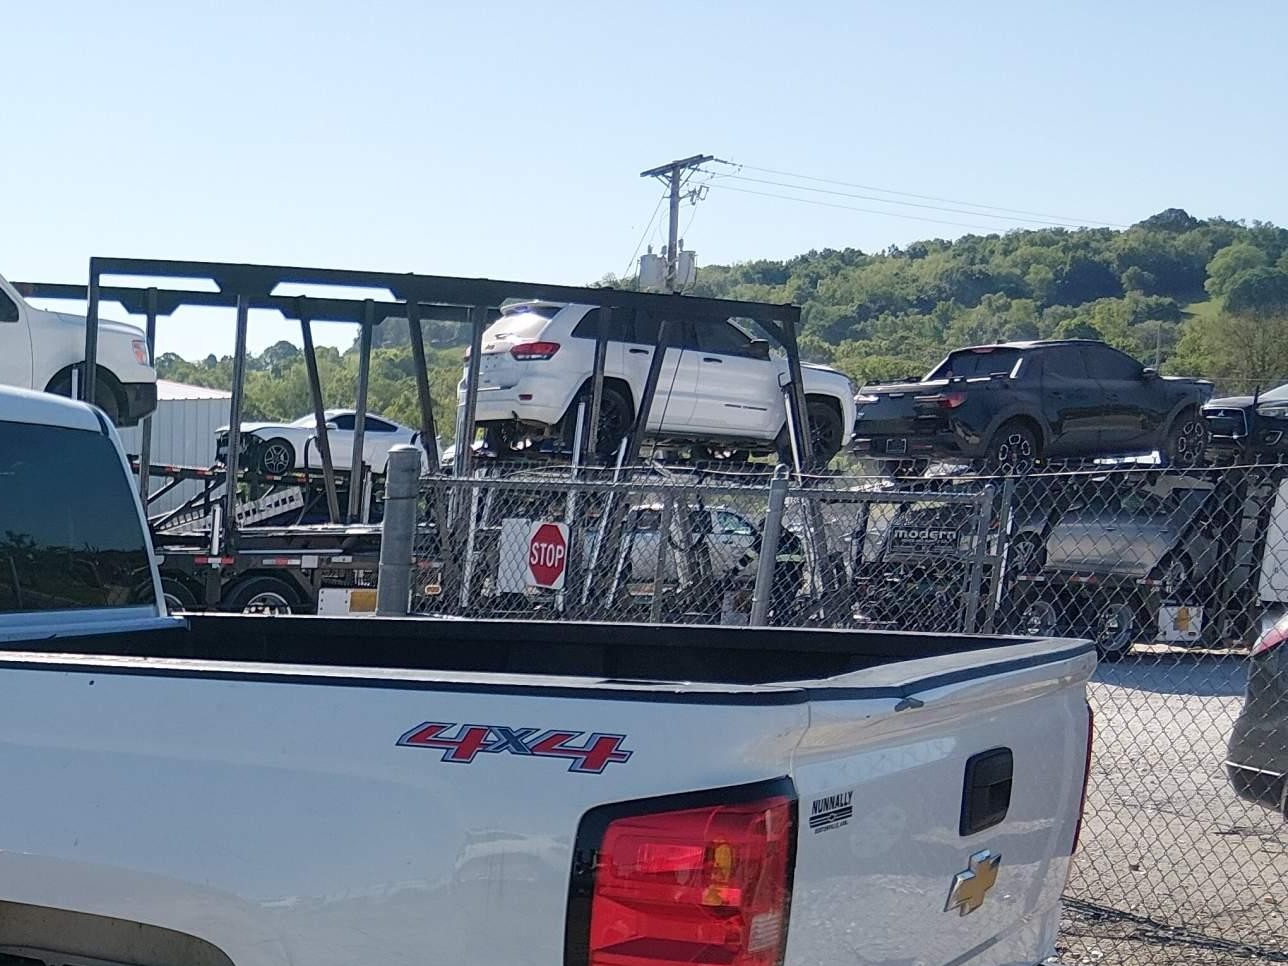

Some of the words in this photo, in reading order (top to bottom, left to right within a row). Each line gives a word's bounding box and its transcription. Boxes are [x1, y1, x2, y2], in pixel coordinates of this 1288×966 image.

[894, 529, 957, 541] modern
[530, 542, 564, 568] STOP
[812, 791, 854, 815] NUNNALLY
